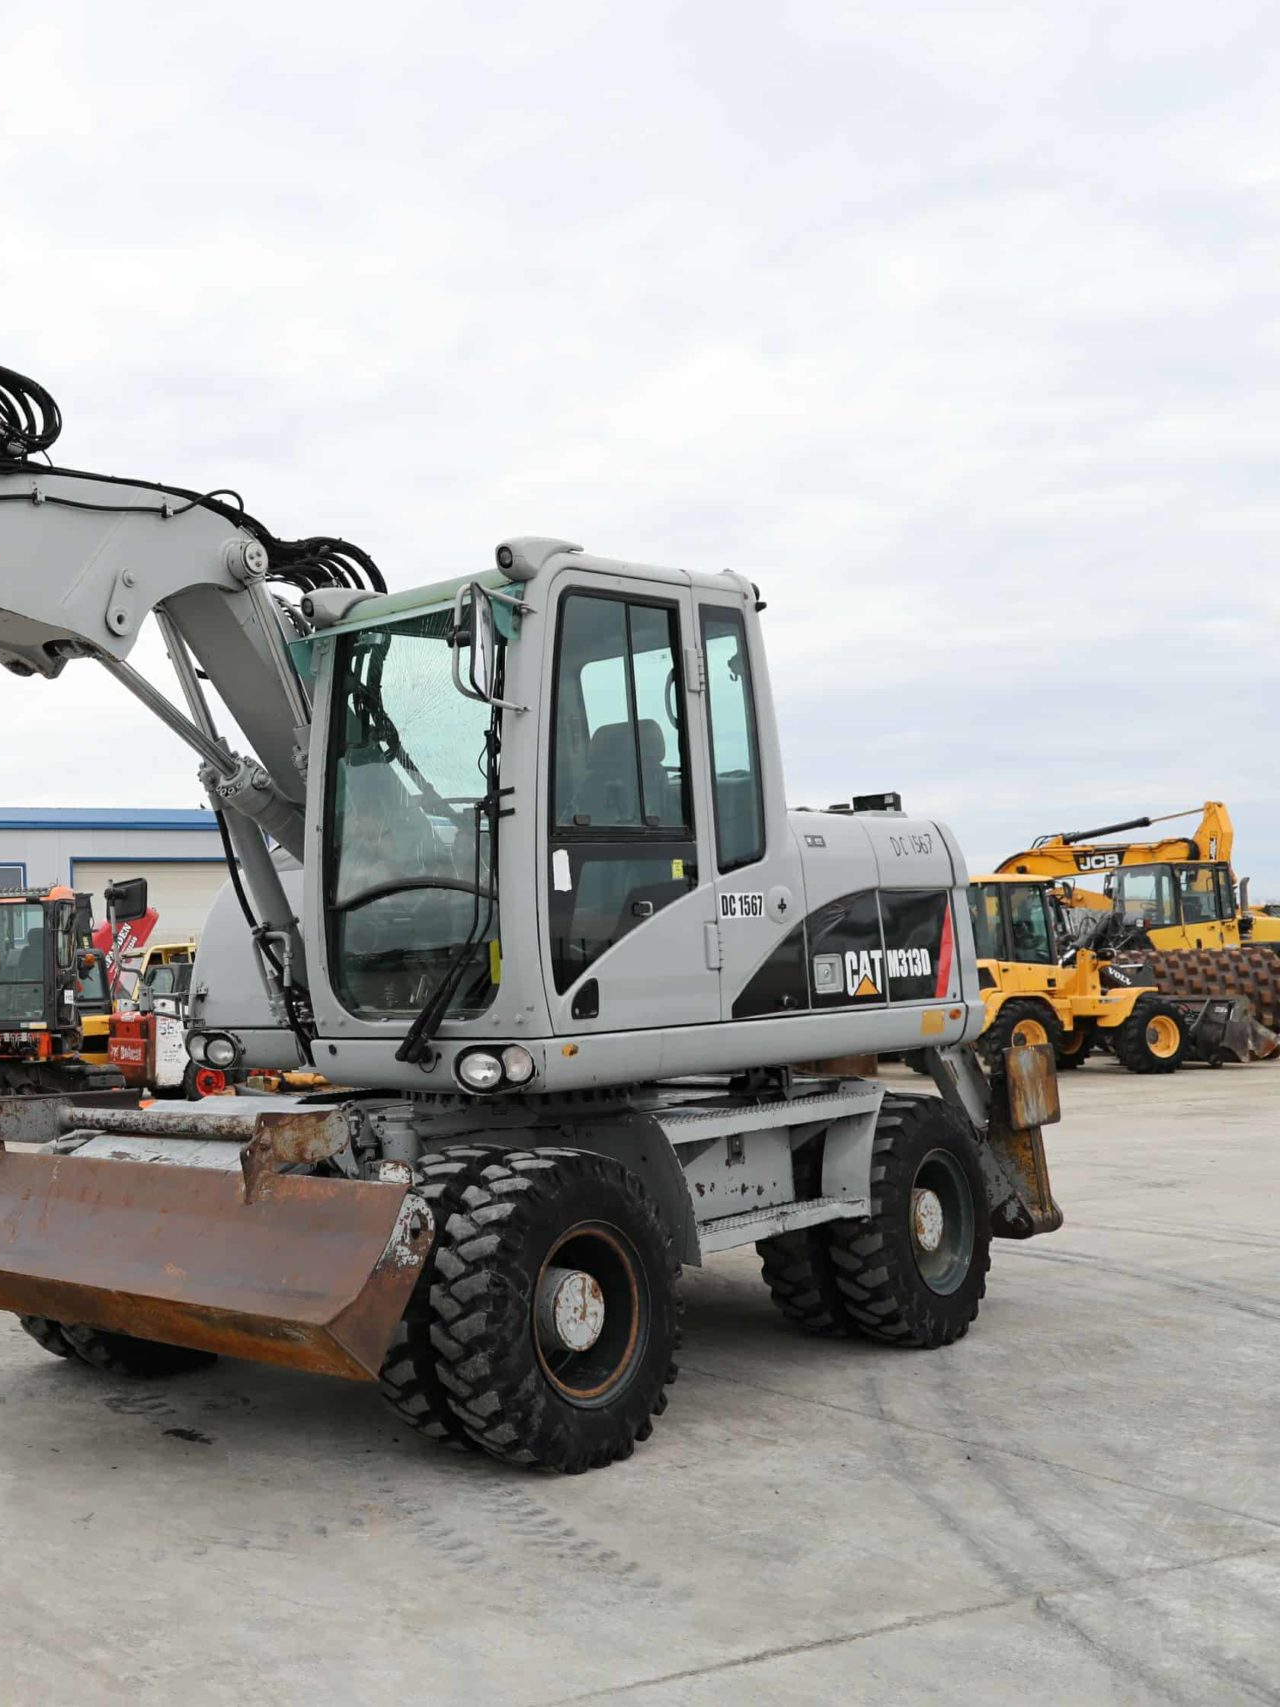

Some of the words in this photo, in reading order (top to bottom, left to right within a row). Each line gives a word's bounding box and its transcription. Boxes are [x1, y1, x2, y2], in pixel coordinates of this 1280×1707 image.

[889, 836, 909, 857] DC
[908, 833, 933, 855] 1567
[1079, 853, 1120, 871] JCB
[721, 894, 736, 917] DC
[738, 894, 763, 917] 1567
[844, 950, 883, 997] CAT
[886, 948, 932, 978] M313D
[1107, 966, 1133, 986] VOLV
